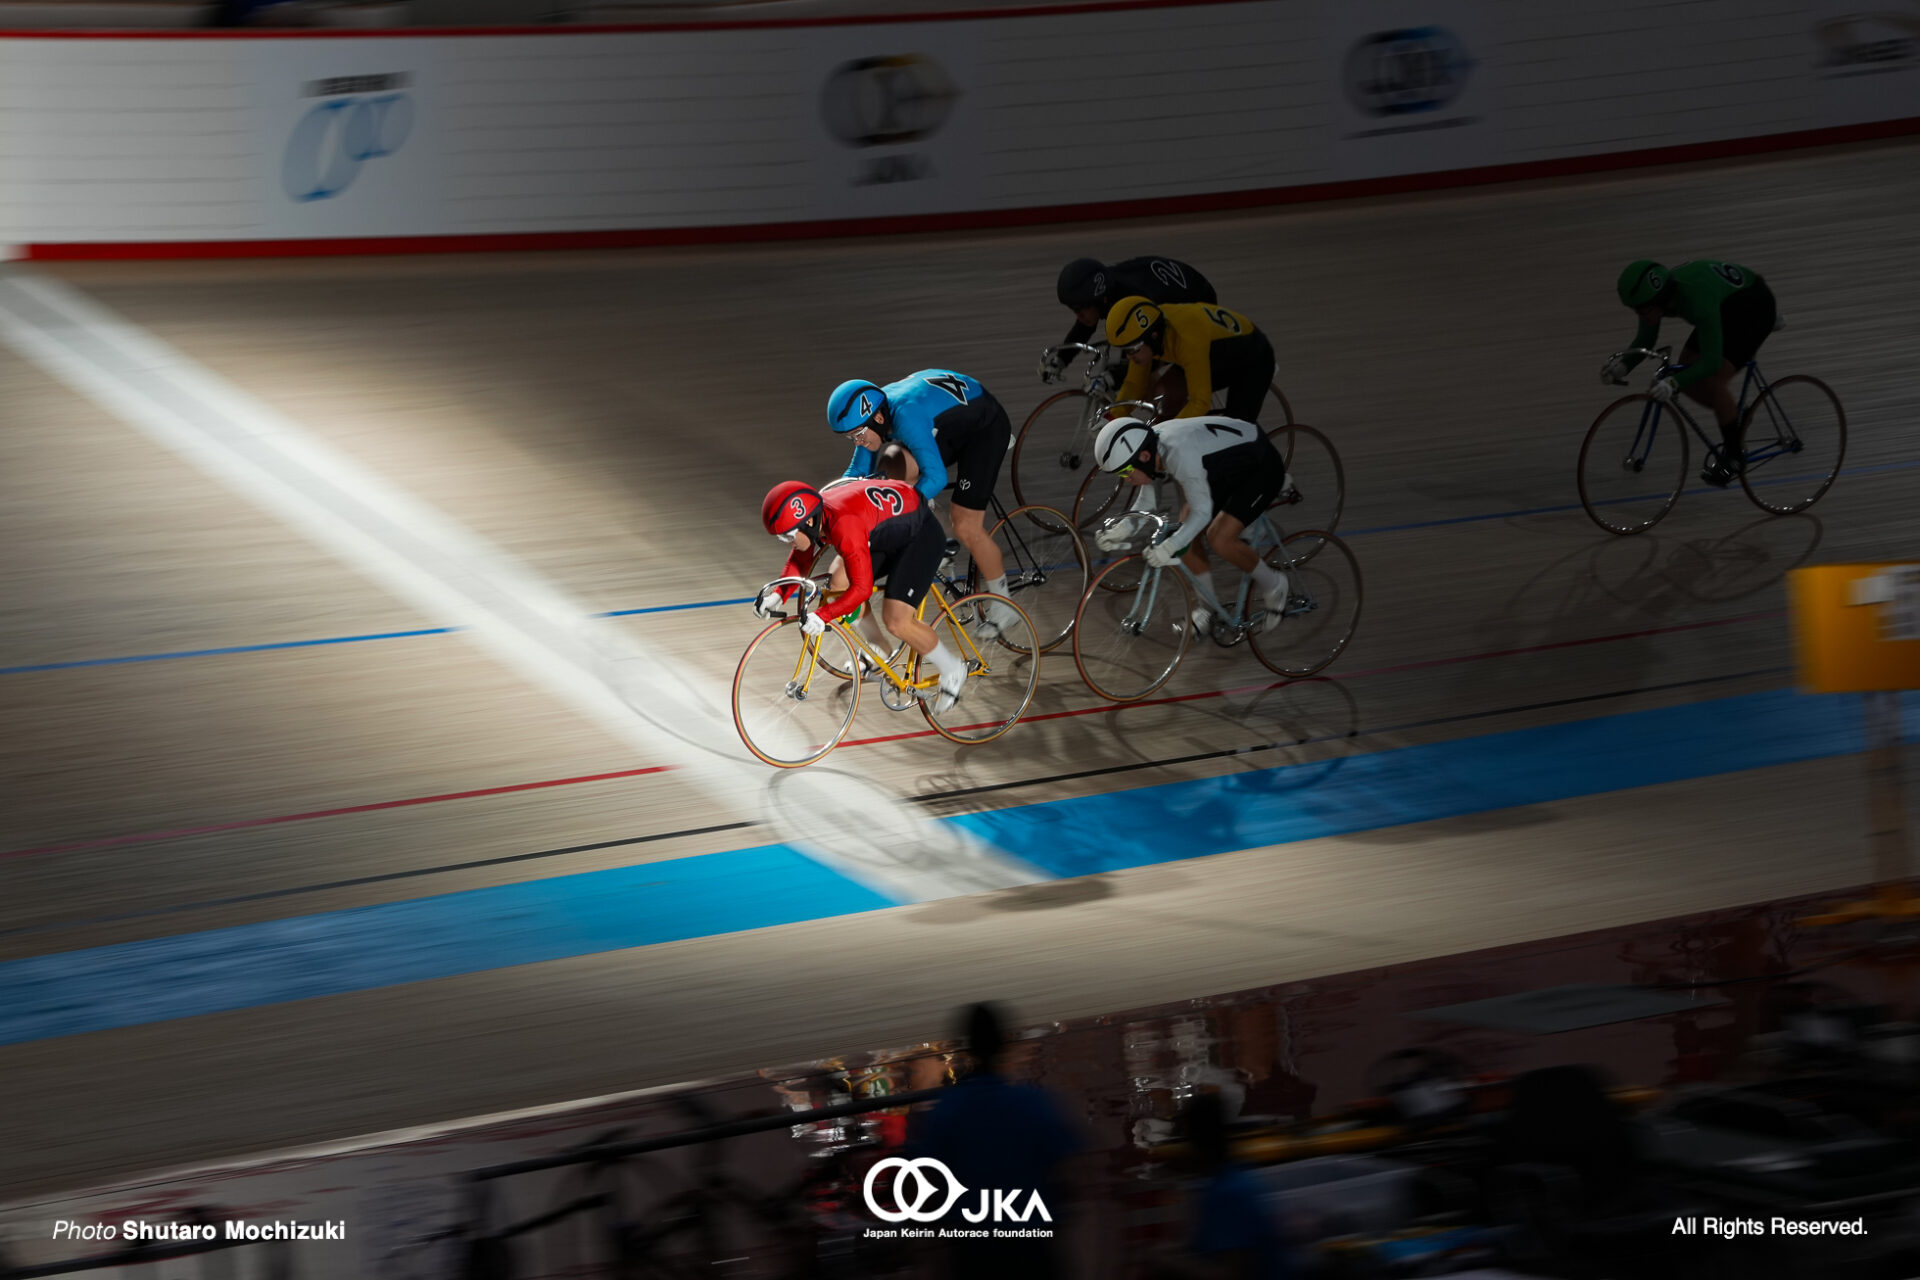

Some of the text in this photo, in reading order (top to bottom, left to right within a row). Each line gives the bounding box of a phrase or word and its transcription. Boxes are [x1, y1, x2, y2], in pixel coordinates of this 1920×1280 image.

[1093, 272, 1107, 297] 2
[1150, 259, 1188, 289] 2
[1648, 269, 1664, 291] 6
[1710, 263, 1745, 288] 6
[1135, 308, 1150, 329] 5
[1202, 306, 1241, 335] 5
[922, 373, 969, 406] 4
[860, 393, 873, 417] 4
[1205, 423, 1243, 437] 1
[1120, 436, 1134, 454] 1
[790, 497, 806, 519] 3
[865, 486, 904, 515] 3
